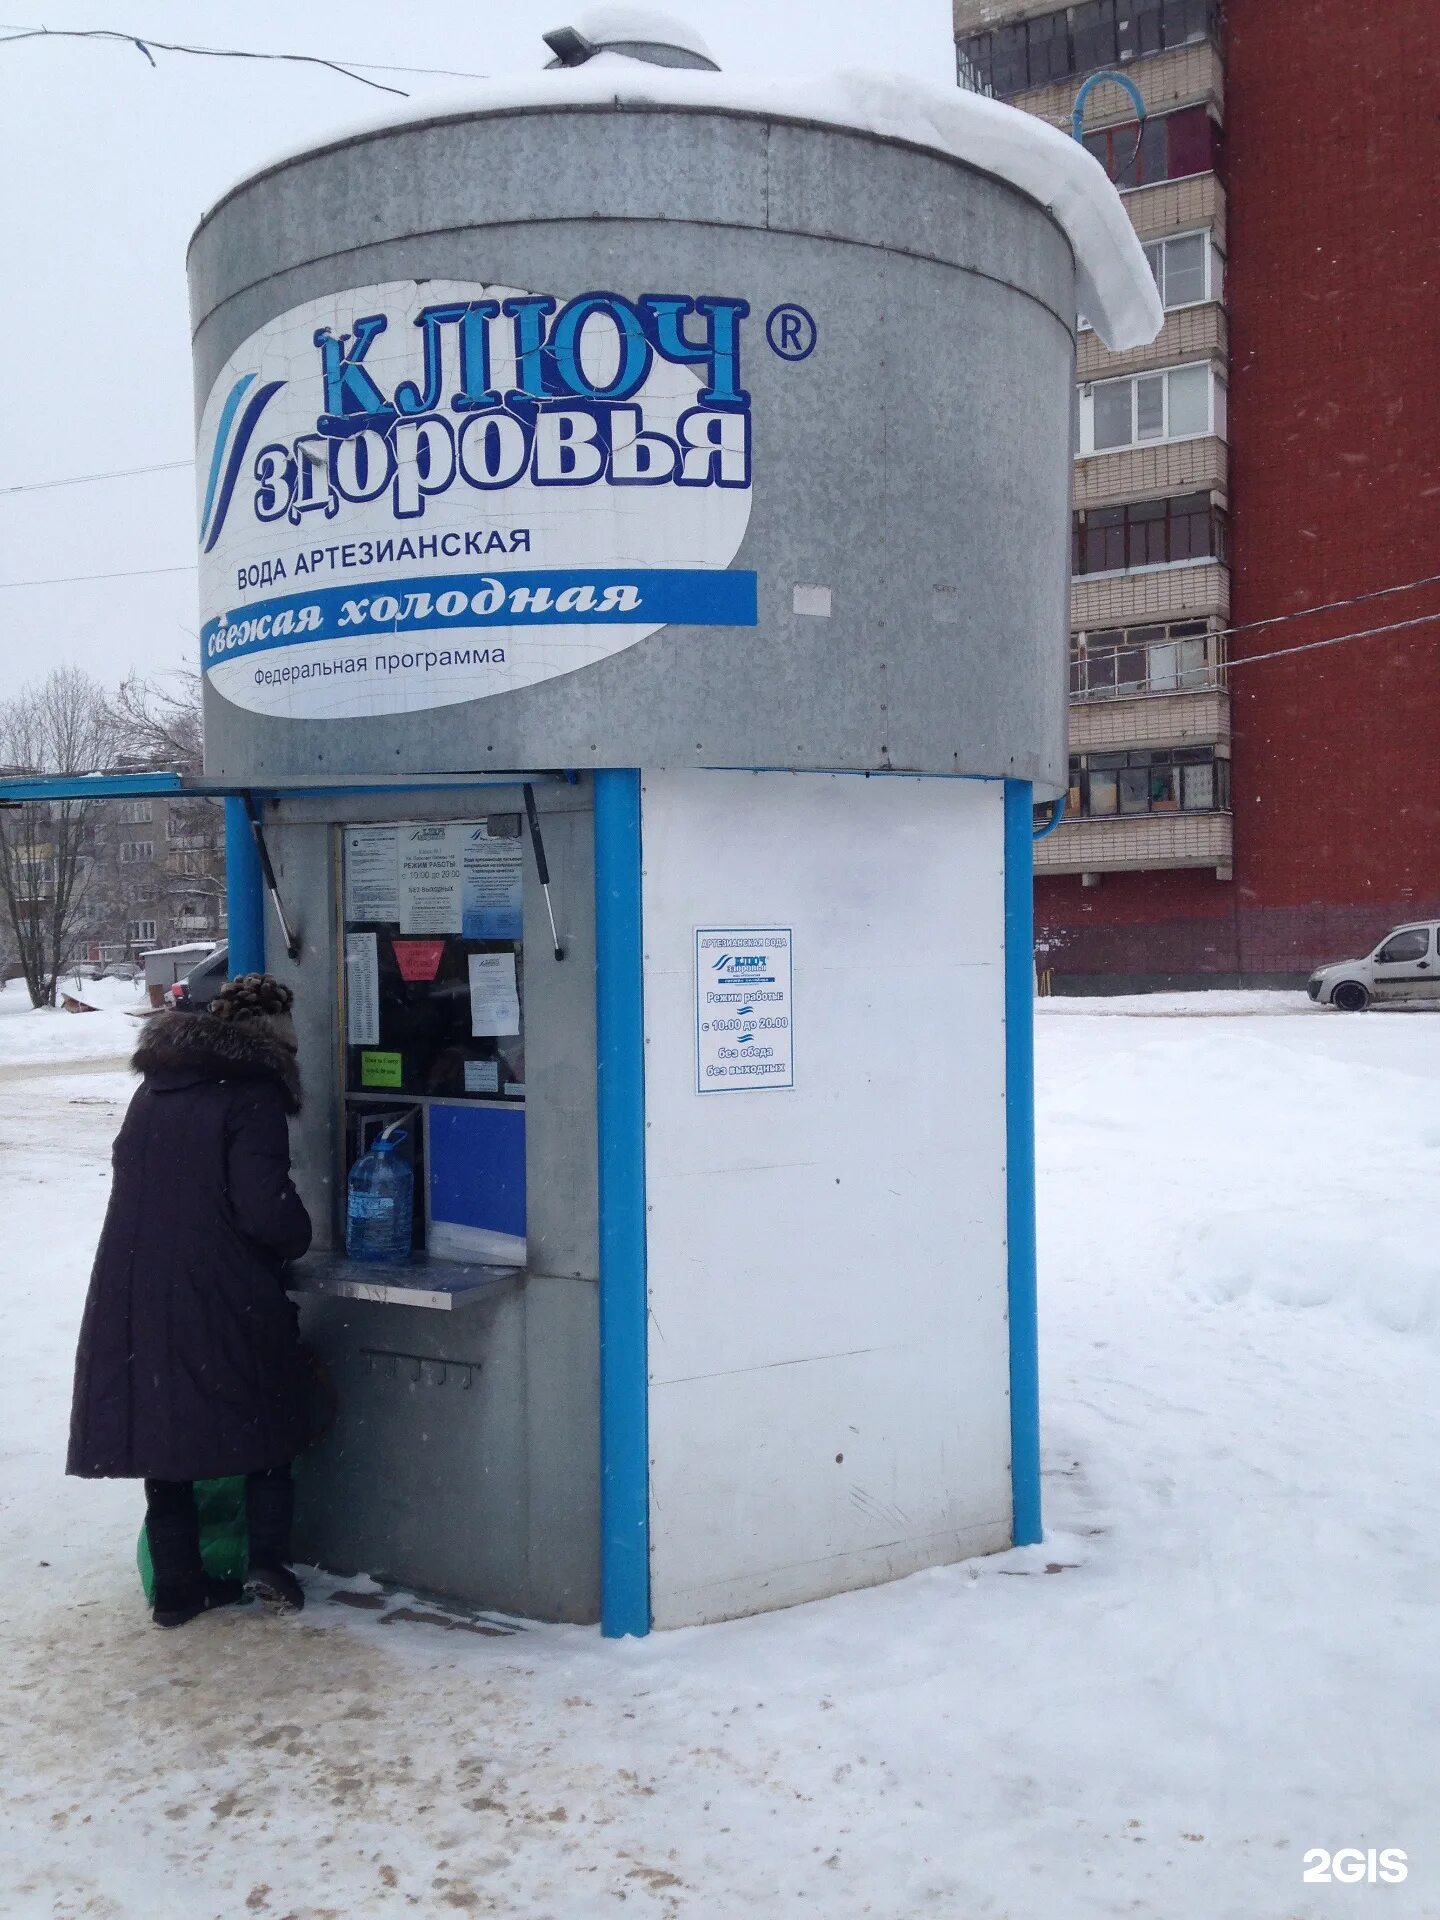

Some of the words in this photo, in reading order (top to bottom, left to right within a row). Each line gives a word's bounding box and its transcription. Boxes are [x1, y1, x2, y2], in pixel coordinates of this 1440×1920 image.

[313, 291, 751, 424] КЛЮЧ
[237, 557, 288, 591] ВОДА
[294, 528, 531, 576] АРТЕЗИАНСКАЯ
[207, 604, 324, 658] свежая
[337, 577, 643, 627] холодная
[254, 656, 367, 686] Федеральная
[375, 648, 506, 674] программа
[701, 938, 764, 948] АРТЕЗИАНСКАЯ
[765, 938, 787, 948] ВОДА
[707, 992, 742, 1003] Режим
[744, 991, 784, 1004] работы:
[702, 1022, 709, 1031] с
[712, 1019, 741, 1031] 10.00
[743, 1020, 757, 1031] до
[759, 1017, 788, 1029] 20.00
[718, 1048, 738, 1058] без
[741, 1047, 773, 1058] обеда
[706, 1065, 727, 1076] без
[729, 1063, 785, 1075] выходных
